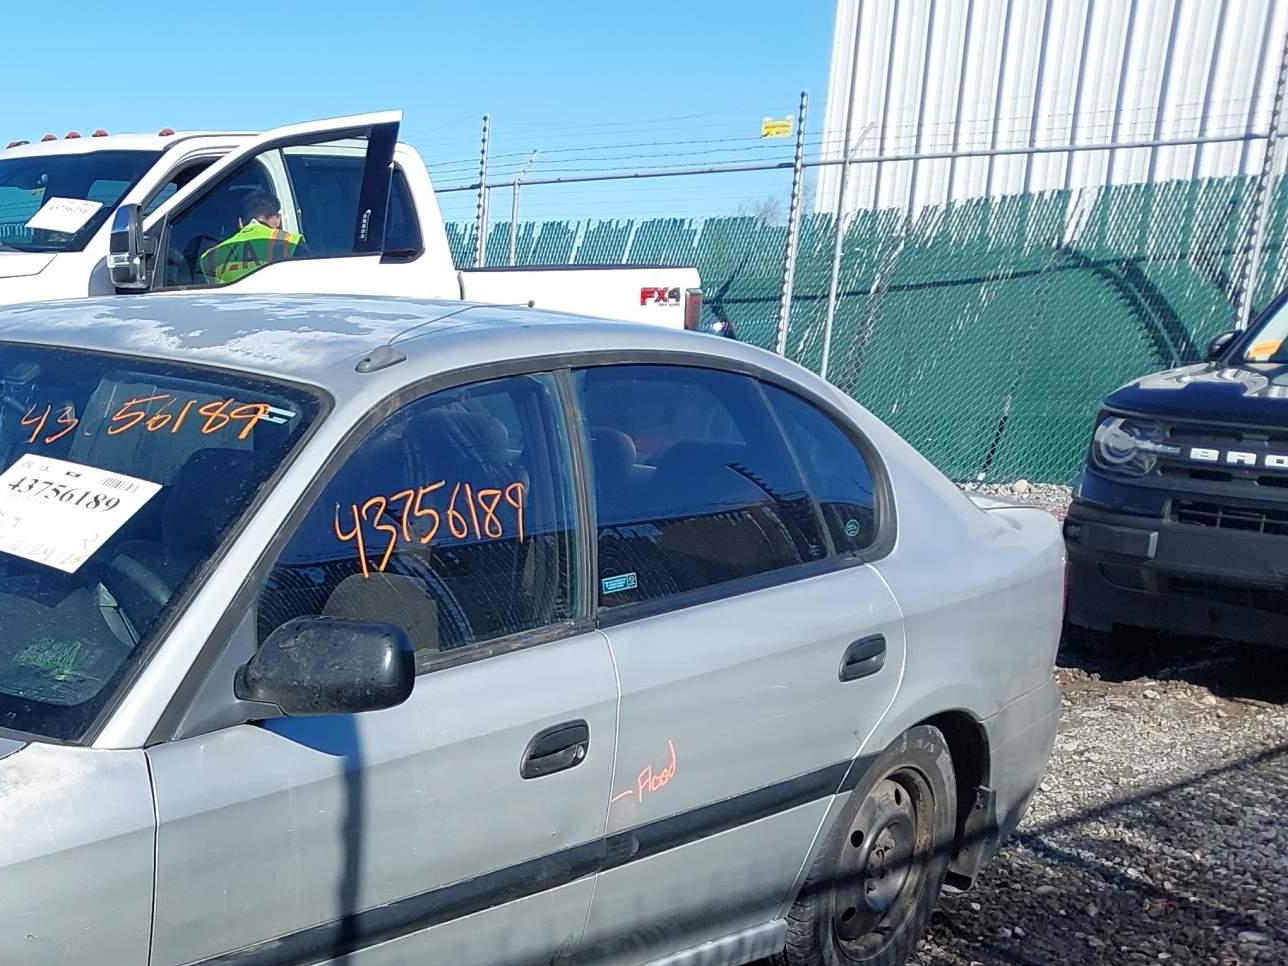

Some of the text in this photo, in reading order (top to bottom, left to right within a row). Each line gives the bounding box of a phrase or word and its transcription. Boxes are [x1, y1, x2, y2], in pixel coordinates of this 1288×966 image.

[640, 287, 681, 306] FX4
[8, 475, 120, 513] 43756189
[335, 480, 524, 579] 43756189
